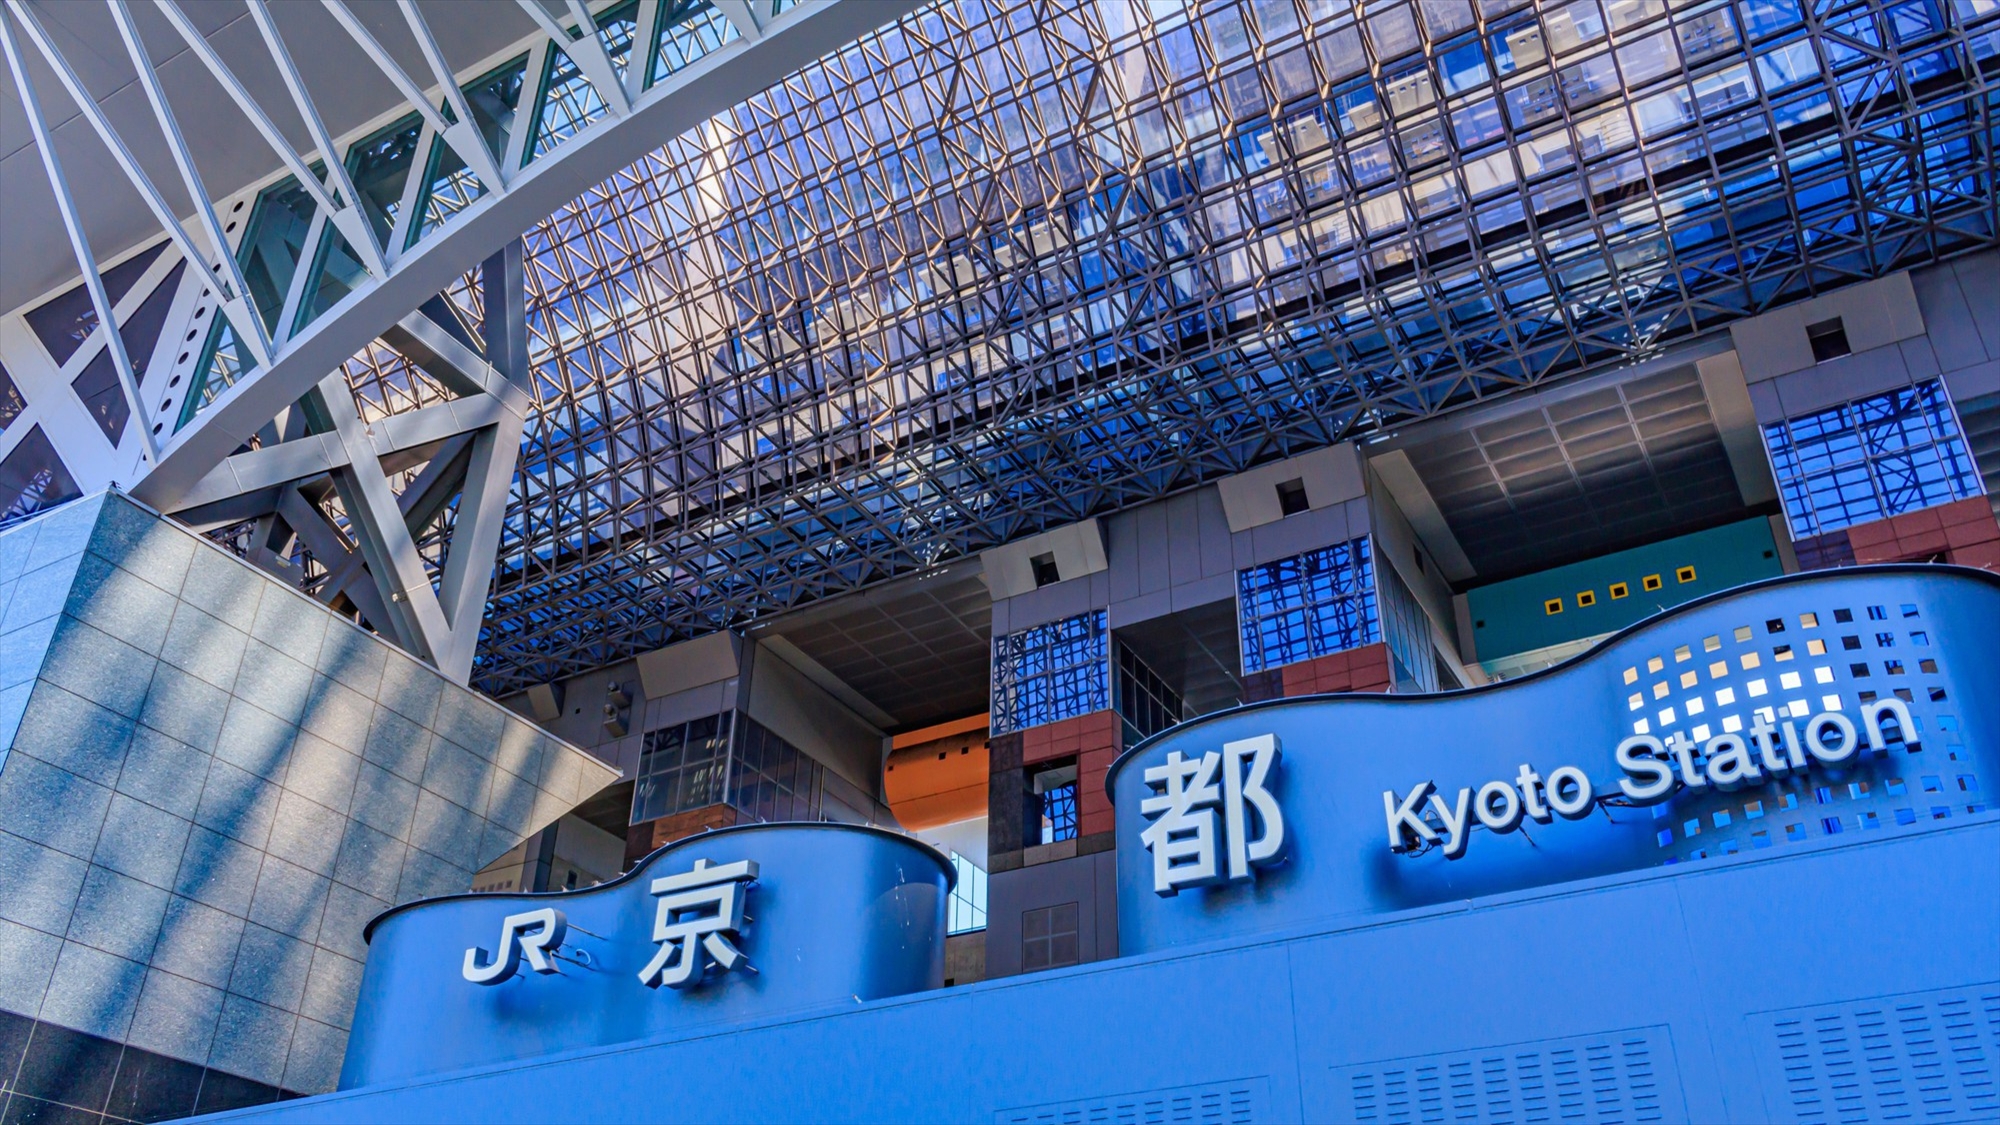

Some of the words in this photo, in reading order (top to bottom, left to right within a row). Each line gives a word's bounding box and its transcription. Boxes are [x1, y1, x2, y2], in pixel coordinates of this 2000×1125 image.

[1140, 734, 1285, 898] 都
[1383, 765, 1593, 859] Kyoto
[1615, 697, 1920, 806] Station
[462, 908, 564, 985] JR
[637, 858, 759, 989] 京
